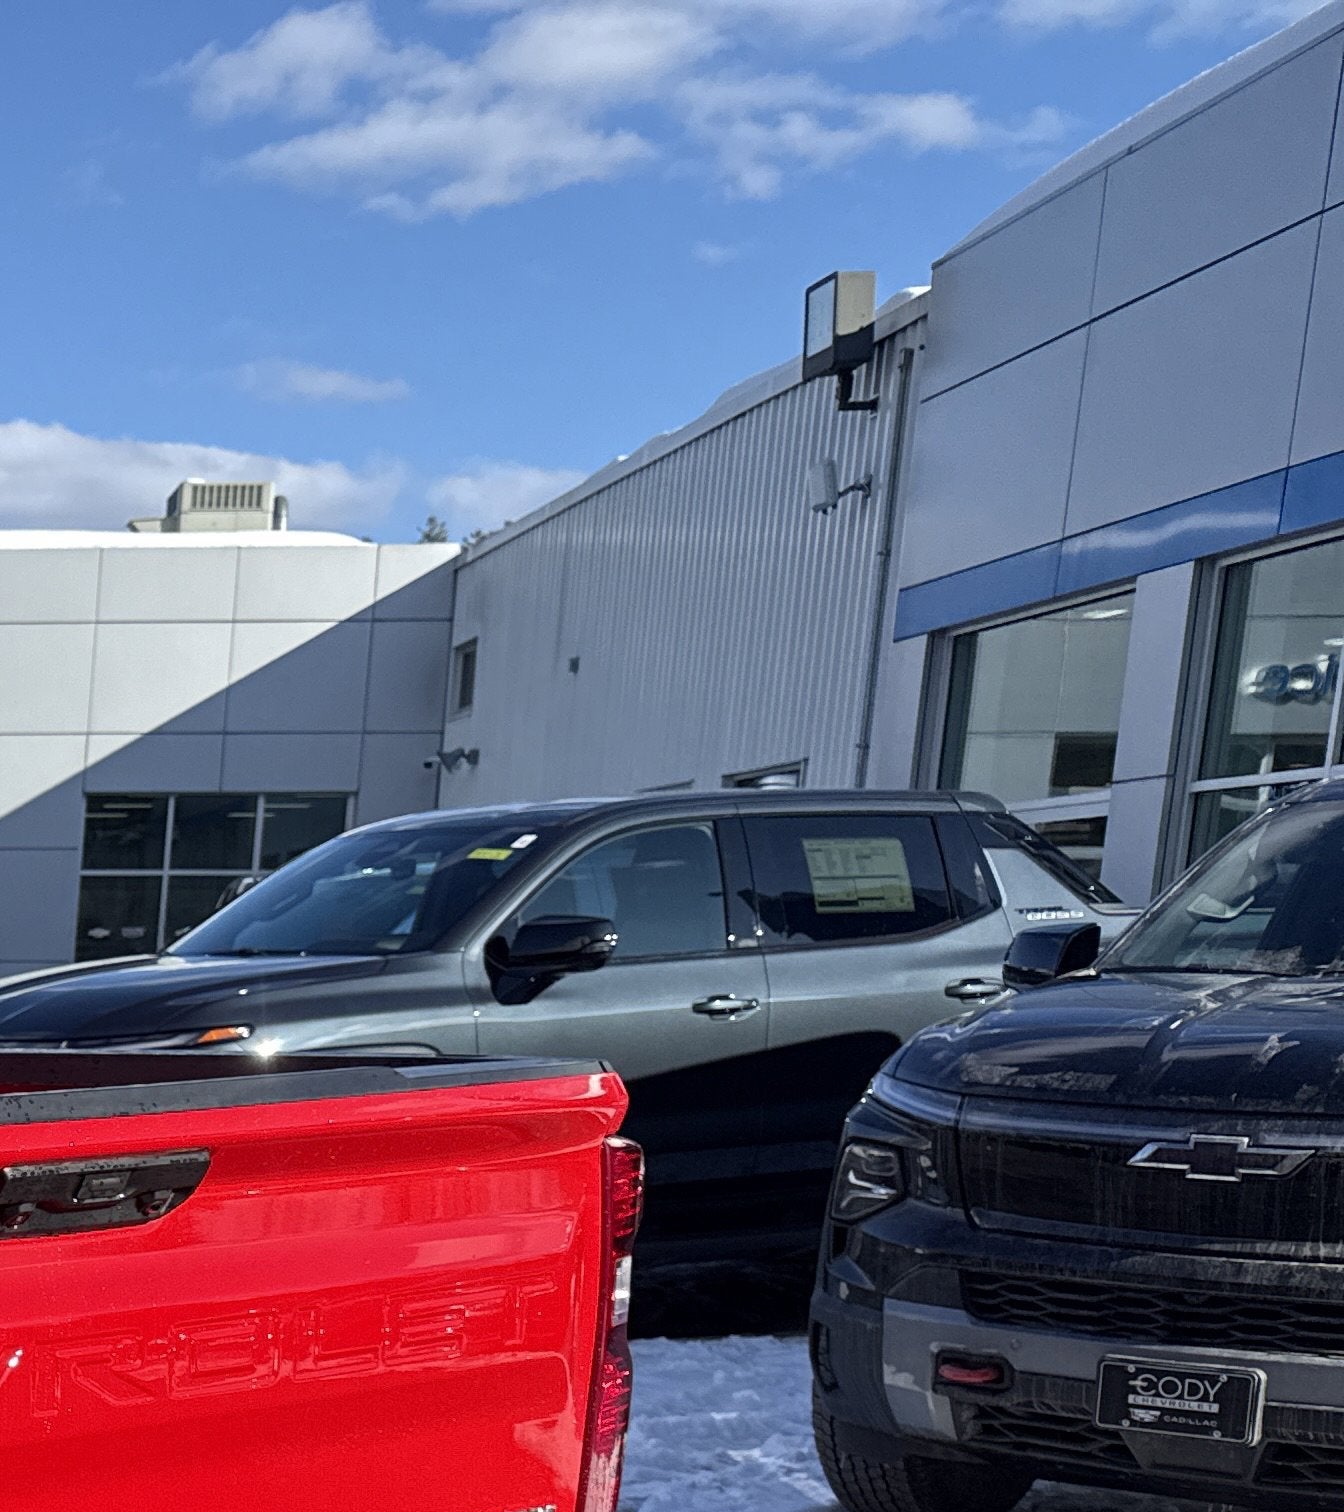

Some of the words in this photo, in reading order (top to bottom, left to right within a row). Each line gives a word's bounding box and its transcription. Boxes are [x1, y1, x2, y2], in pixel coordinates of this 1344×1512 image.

[1128, 1373, 1223, 1401] CODY
[1131, 1396, 1216, 1411] CHEVROLET
[1163, 1415, 1218, 1427] CADILLAC
